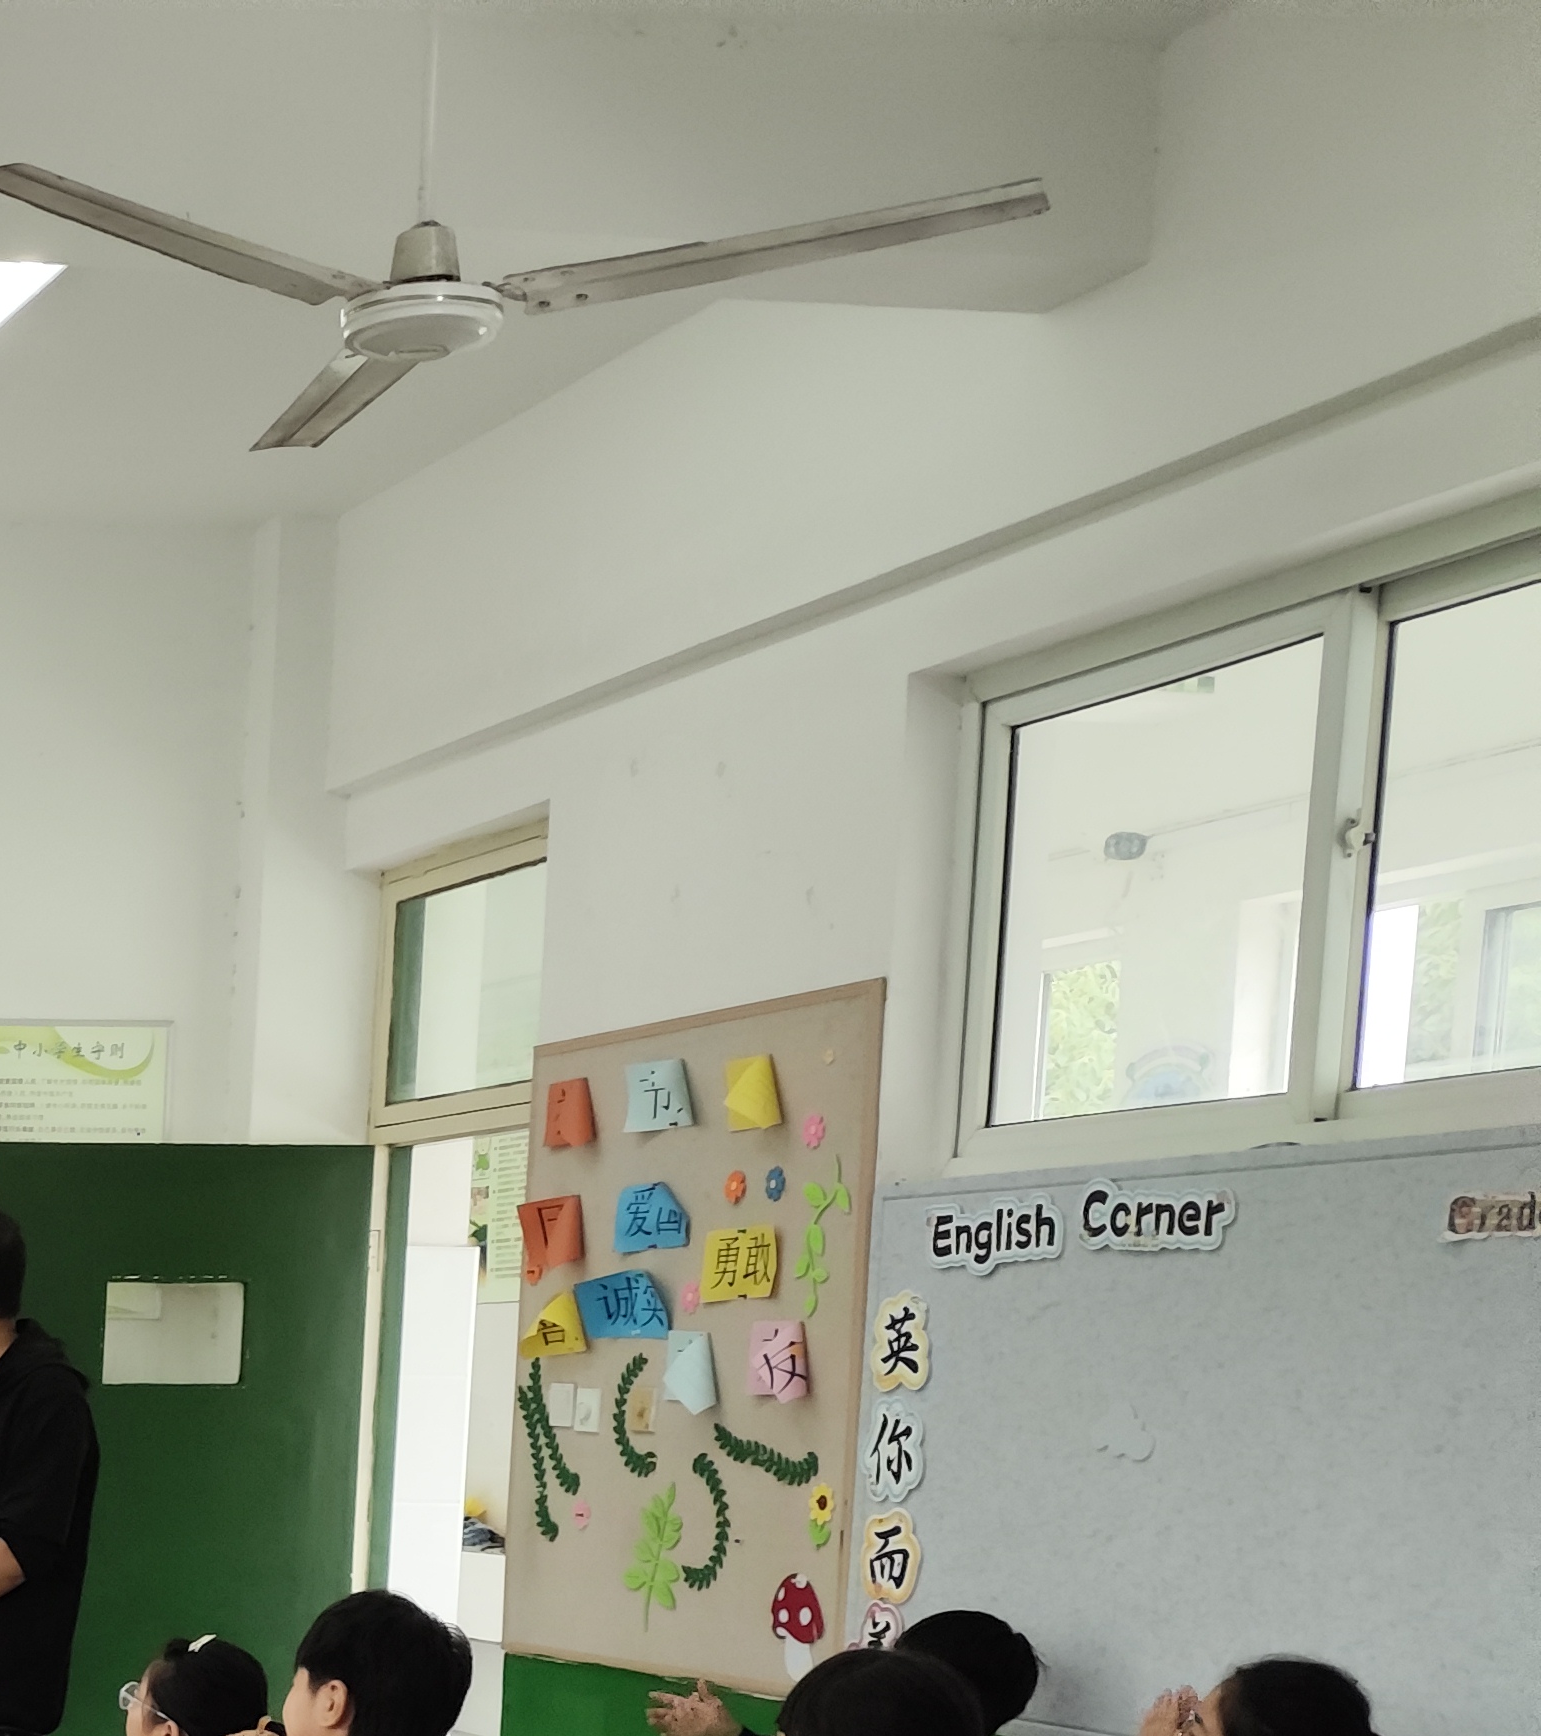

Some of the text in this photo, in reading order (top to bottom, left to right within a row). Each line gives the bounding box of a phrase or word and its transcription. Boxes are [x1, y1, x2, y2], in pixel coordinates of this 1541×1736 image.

[13, 1040, 125, 1060] 中小学生守则
[932, 1190, 1226, 1264] English Corner
[710, 1233, 771, 1290] 勇敢
